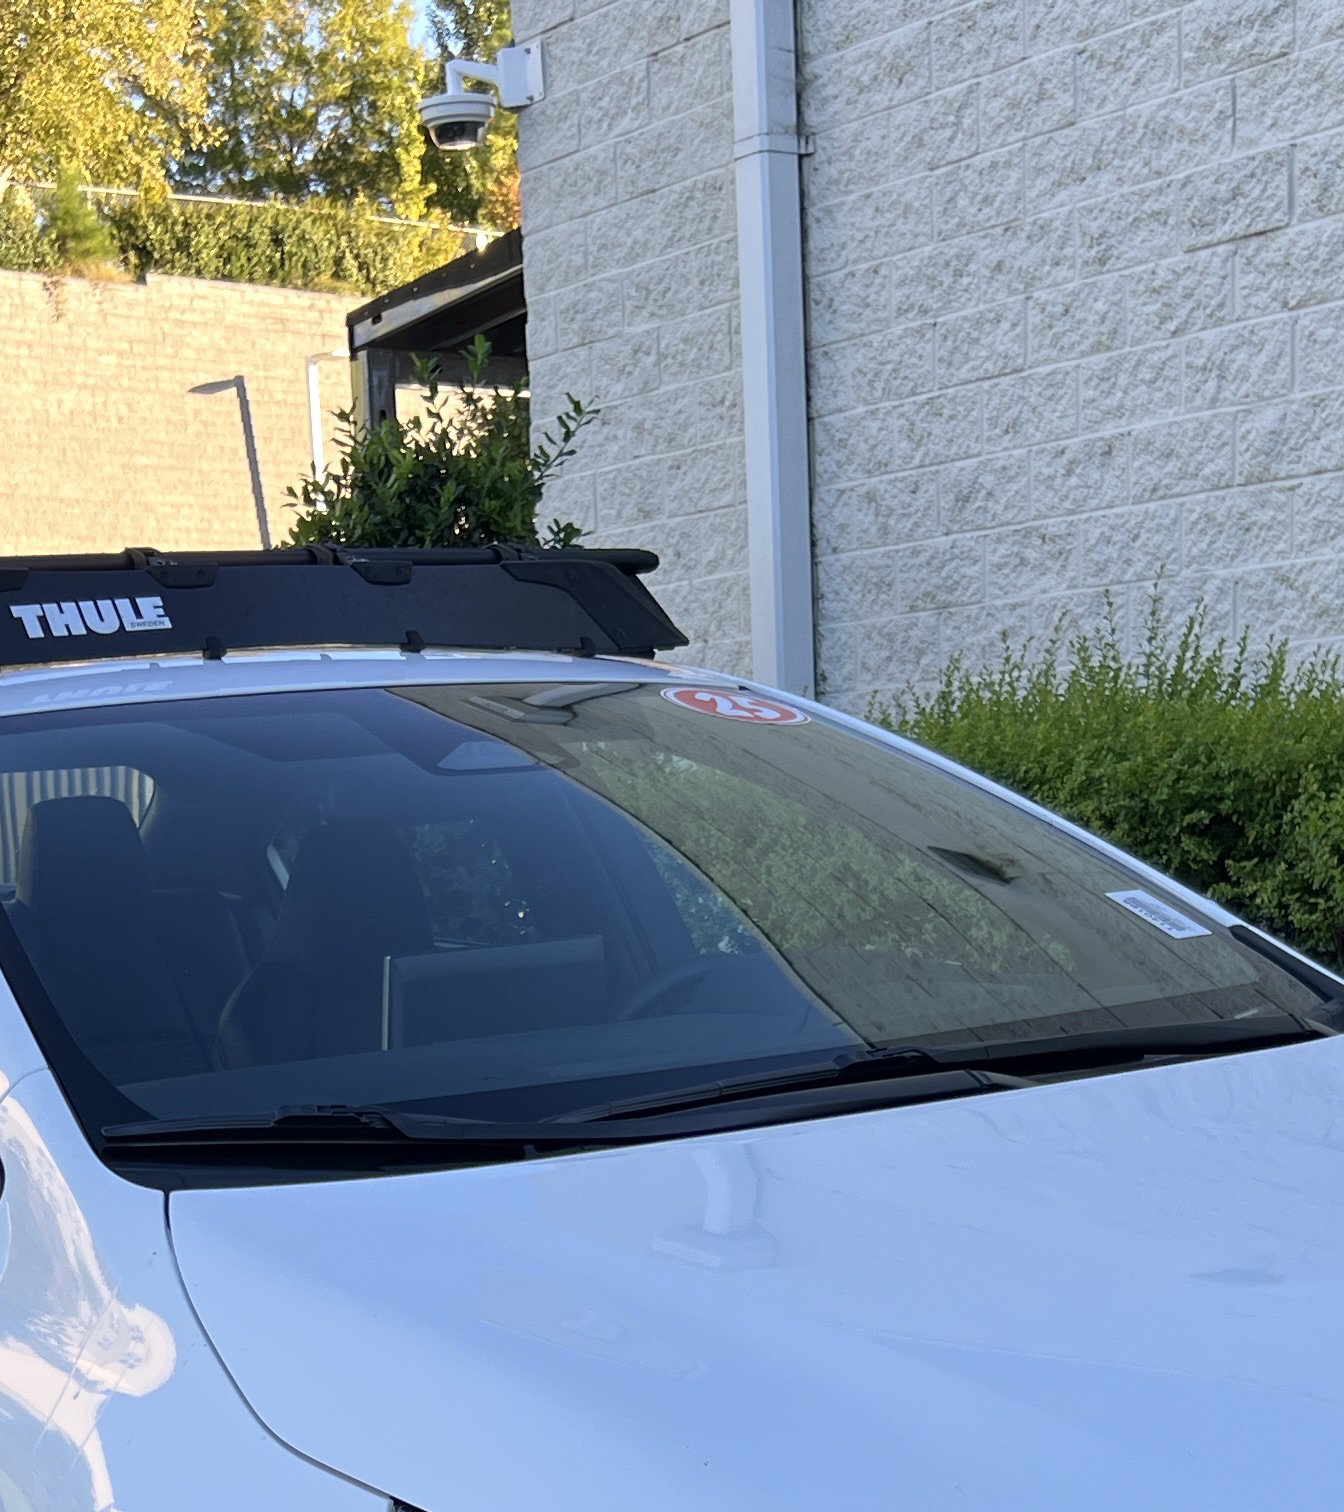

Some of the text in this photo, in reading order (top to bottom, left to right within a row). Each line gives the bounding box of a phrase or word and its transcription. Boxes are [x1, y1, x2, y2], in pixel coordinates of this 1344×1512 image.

[9, 596, 173, 639] THULE
[130, 619, 166, 629] SWEDEN
[694, 691, 781, 720] 25
